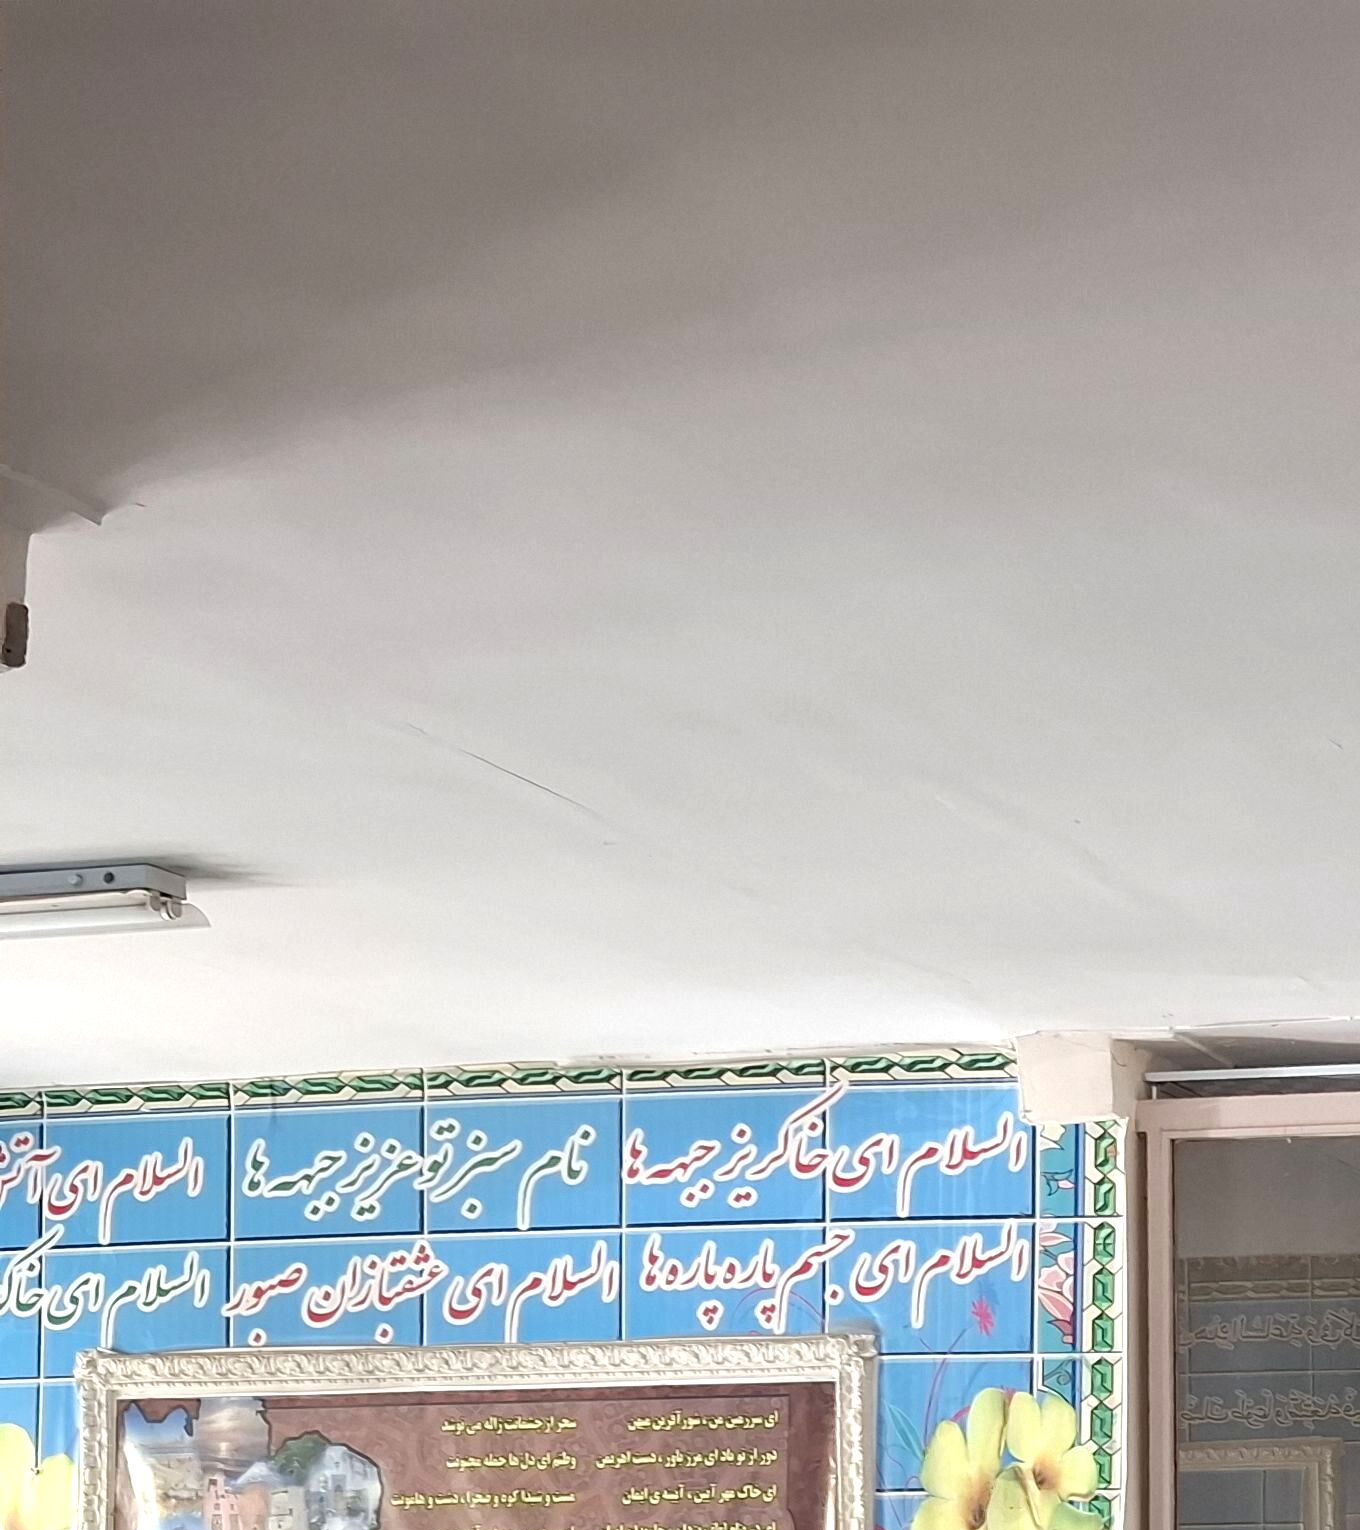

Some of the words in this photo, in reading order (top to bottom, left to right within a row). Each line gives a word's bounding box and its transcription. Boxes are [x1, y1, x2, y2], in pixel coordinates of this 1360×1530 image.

[717, 1082, 848, 1206] خاکریز
[830, 1133, 899, 1193] ای
[899, 1112, 1028, 1217] السلام
[46, 1159, 103, 1220] ای
[99, 1136, 205, 1245] السلام
[338, 1131, 425, 1221] عزیز
[430, 1131, 523, 1218] سبز
[516, 1124, 600, 1231] نام
[442, 1262, 508, 1326] ای
[503, 1241, 621, 1346] السلام
[720, 1239, 783, 1318] پاره
[773, 1226, 856, 1335] جسم
[849, 1239, 916, 1298] ای
[910, 1217, 1030, 1328] السلام
[44, 1272, 103, 1329] ای
[100, 1250, 210, 1348] السلام
[220, 1262, 308, 1347] صبور
[555, 1417, 577, 1434] سحر
[763, 1409, 779, 1428] ای
[536, 1451, 552, 1471] ای
[631, 1451, 658, 1465] دست
[703, 1448, 719, 1467] ای
[735, 1449, 748, 1467] تو
[747, 1447, 758, 1467] از
[758, 1448, 778, 1467] دور
[426, 1496, 435, 1510] و
[492, 1494, 500, 1509] و
[500, 1488, 520, 1507] کوه
[543, 1495, 552, 1508] و
[736, 1483, 763, 1500] خاک
[762, 1483, 778, 1504] ای
